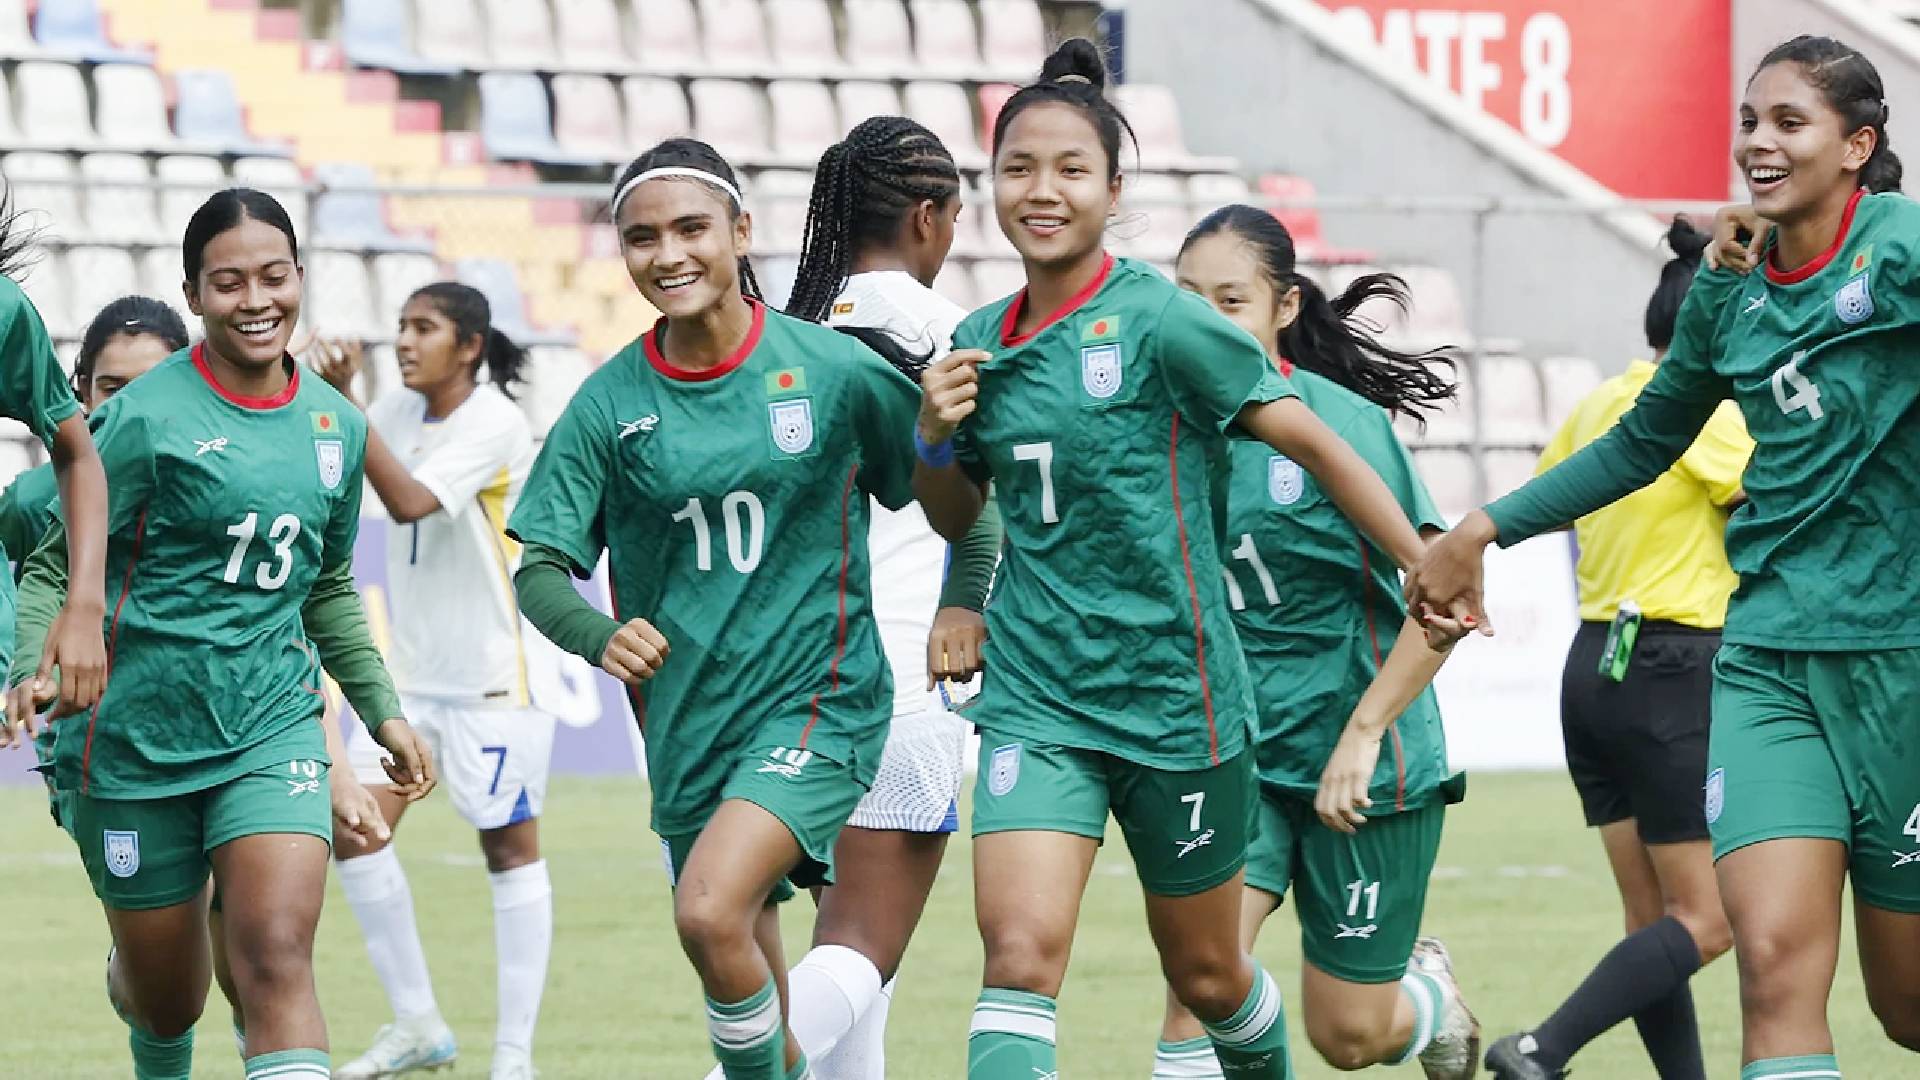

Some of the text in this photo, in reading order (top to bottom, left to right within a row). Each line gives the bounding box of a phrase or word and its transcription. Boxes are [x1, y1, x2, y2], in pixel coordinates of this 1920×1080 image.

[1521, 12, 1571, 148] 8
[1772, 350, 1824, 420] 4
[1013, 442, 1059, 523] 7
[223, 512, 301, 590] 13
[671, 490, 765, 574] 10
[482, 747, 507, 796] 7
[1181, 792, 1205, 831] 7
[1346, 880, 1380, 919] 11
